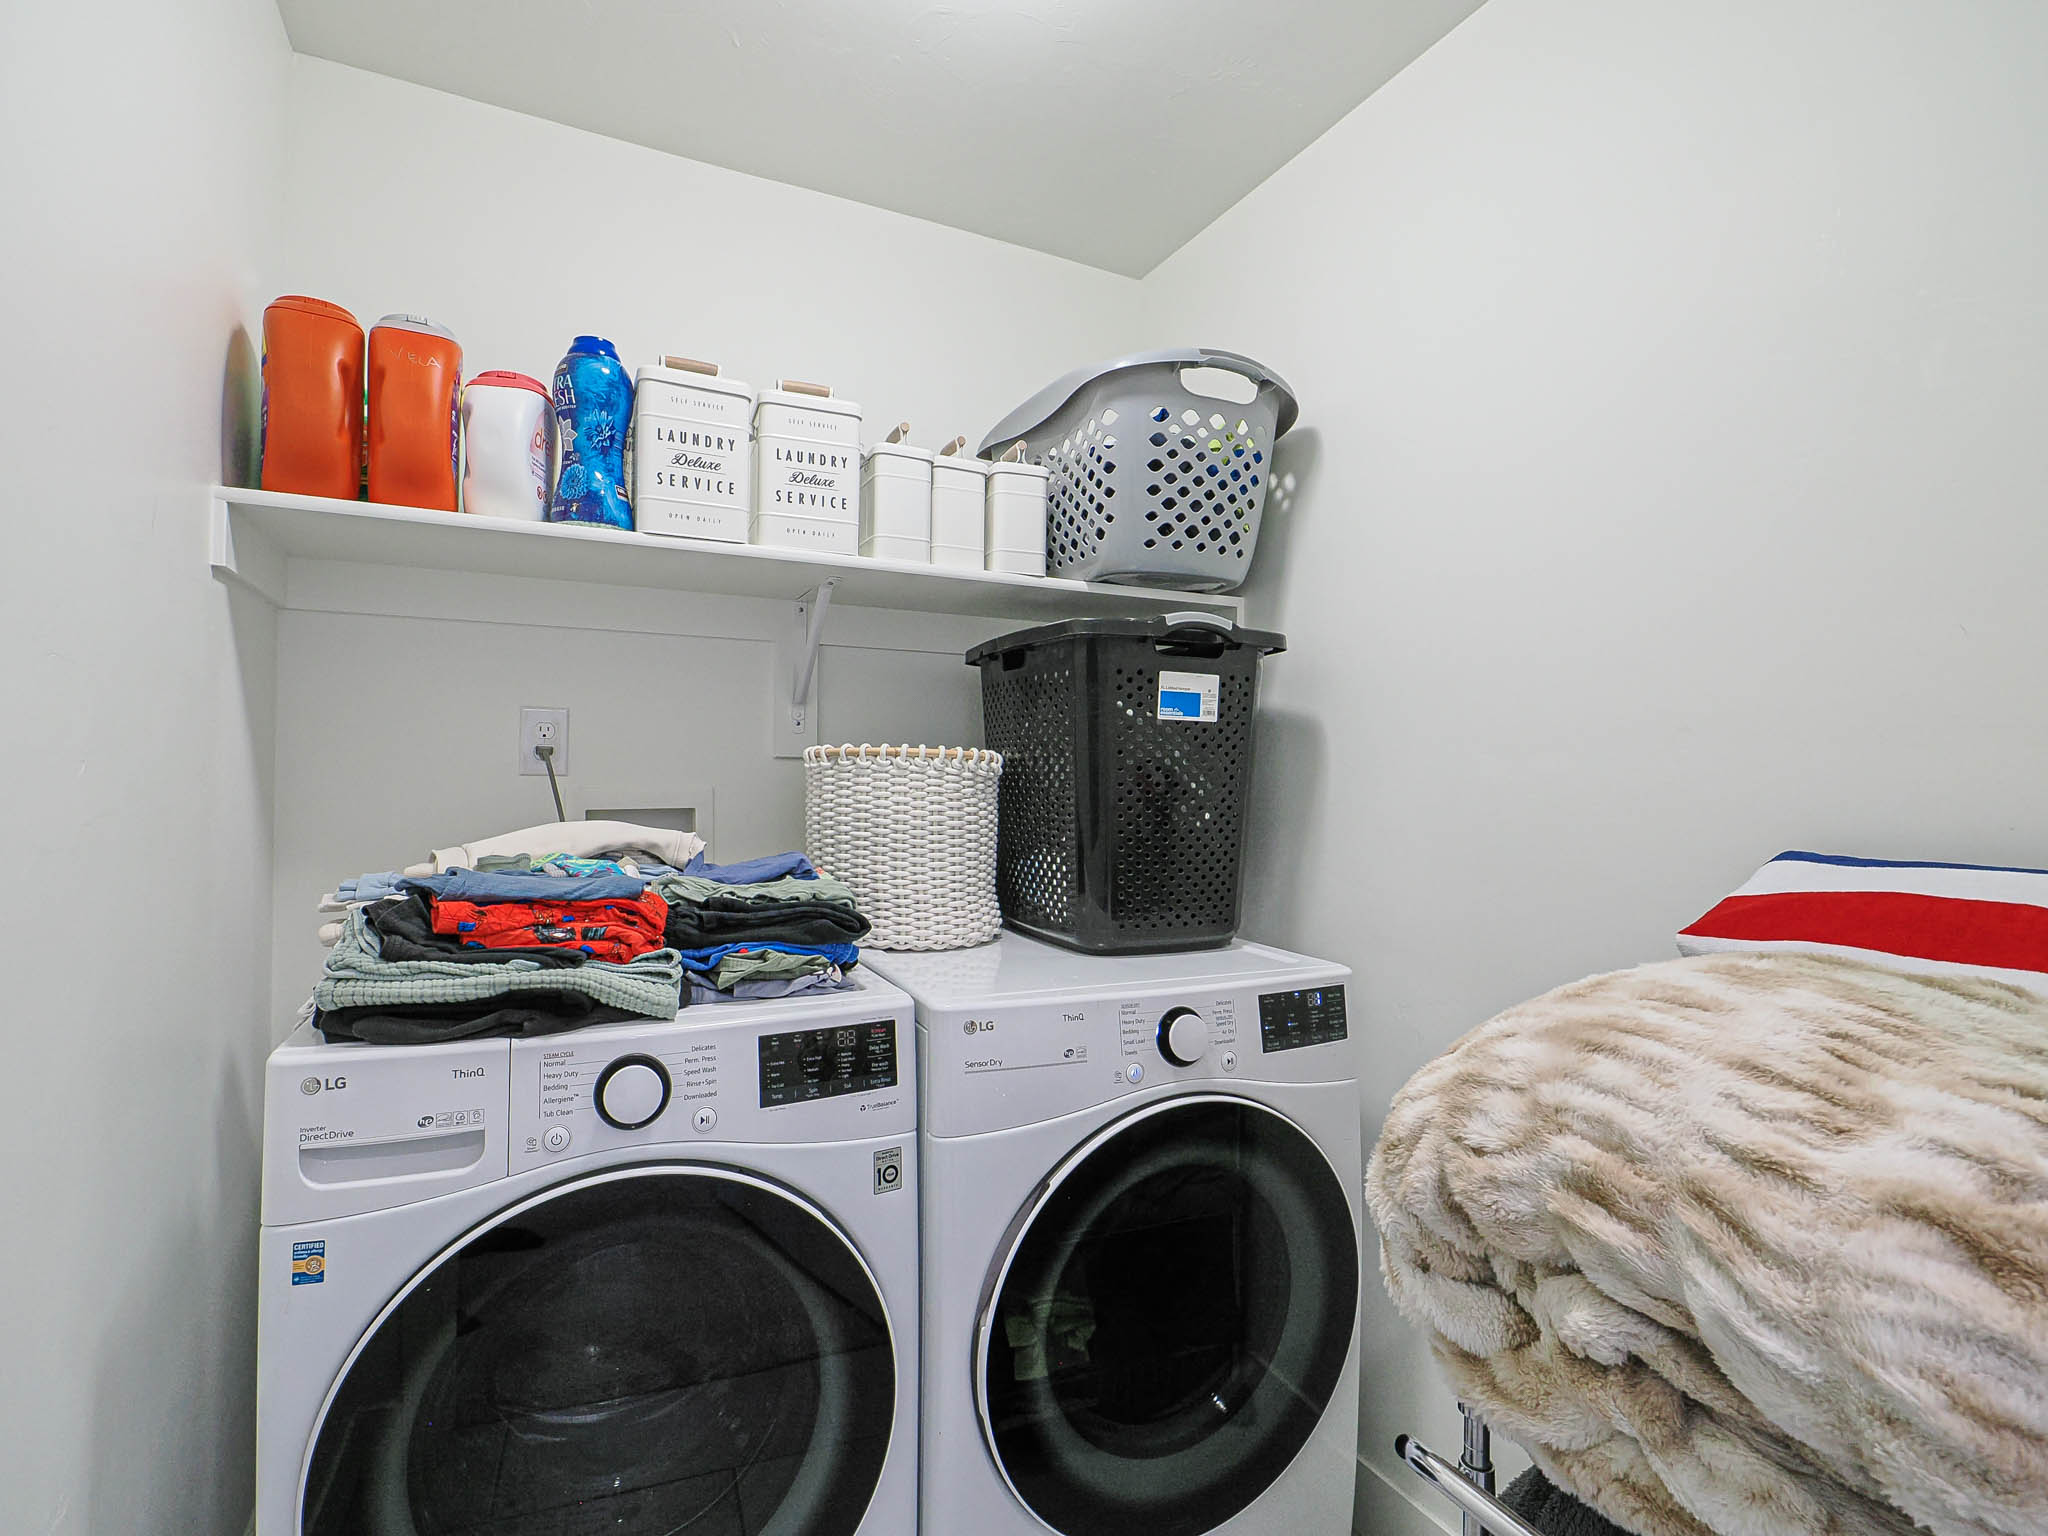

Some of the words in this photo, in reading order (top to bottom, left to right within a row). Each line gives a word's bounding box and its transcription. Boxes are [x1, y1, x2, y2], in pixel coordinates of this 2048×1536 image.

[534, 427, 553, 458] dre
[657, 427, 736, 452] LAUNDRY
[670, 452, 722, 472] Deluxe
[776, 447, 848, 469] LAUNDRY
[656, 471, 736, 496] SERVICE
[788, 471, 836, 489] Deluxe
[775, 489, 848, 511] SERVICE
[1062, 1013, 1085, 1023] ThinQ
[979, 1021, 995, 1032] LG
[691, 1044, 717, 1052] Delicates
[543, 1060, 567, 1068] Normal
[451, 1067, 486, 1080] ThinQ
[683, 1068, 701, 1076] Speed
[324, 1077, 348, 1091] LG
[543, 1083, 569, 1092] Bedding
[683, 1090, 718, 1100] Downloaded
[555, 1109, 574, 1117] Clean
[299, 1125, 327, 1133] Inverter
